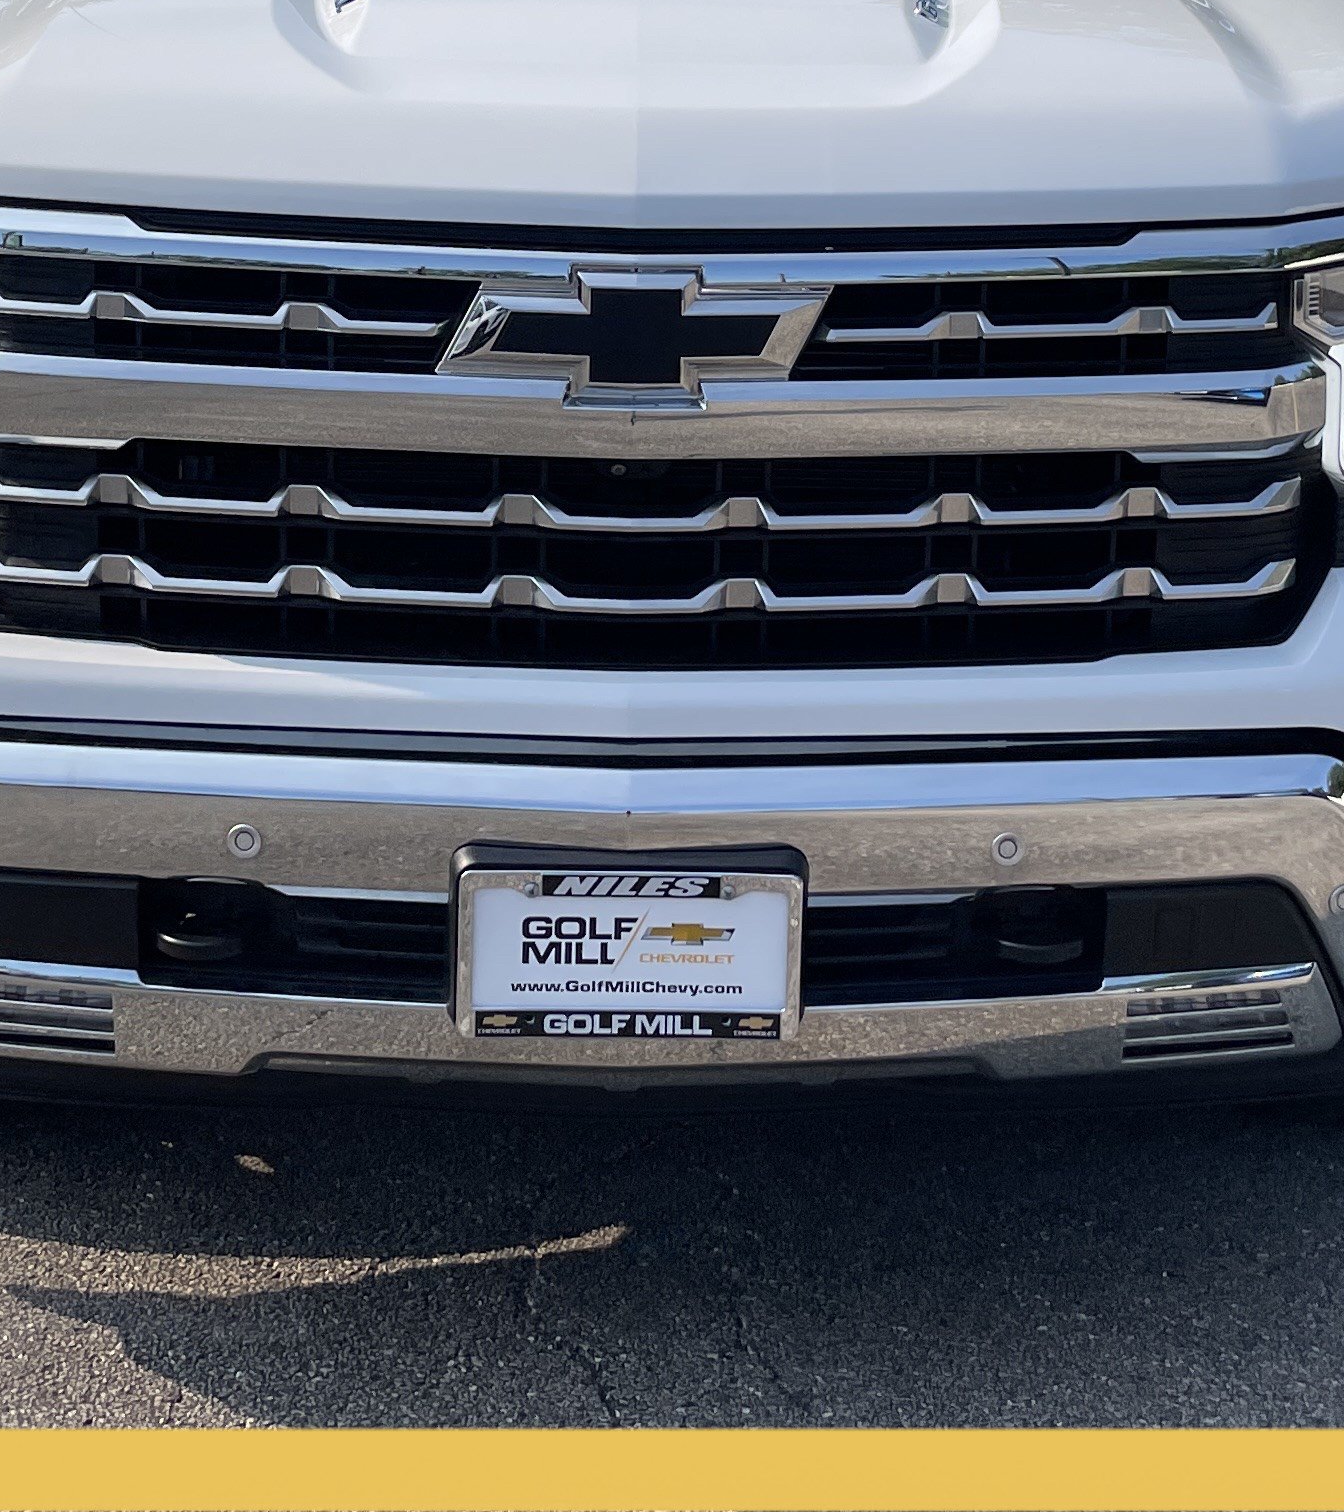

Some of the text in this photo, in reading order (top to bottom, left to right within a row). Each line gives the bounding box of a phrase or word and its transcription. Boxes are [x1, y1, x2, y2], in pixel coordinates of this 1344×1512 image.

[552, 876, 710, 898] NILES
[521, 916, 639, 940] GOLF
[521, 941, 615, 965] MILL
[639, 953, 736, 965] CHEVROLET
[511, 980, 743, 996] www.GolfMillChevy.com
[543, 1013, 713, 1036] GOLF MILL
